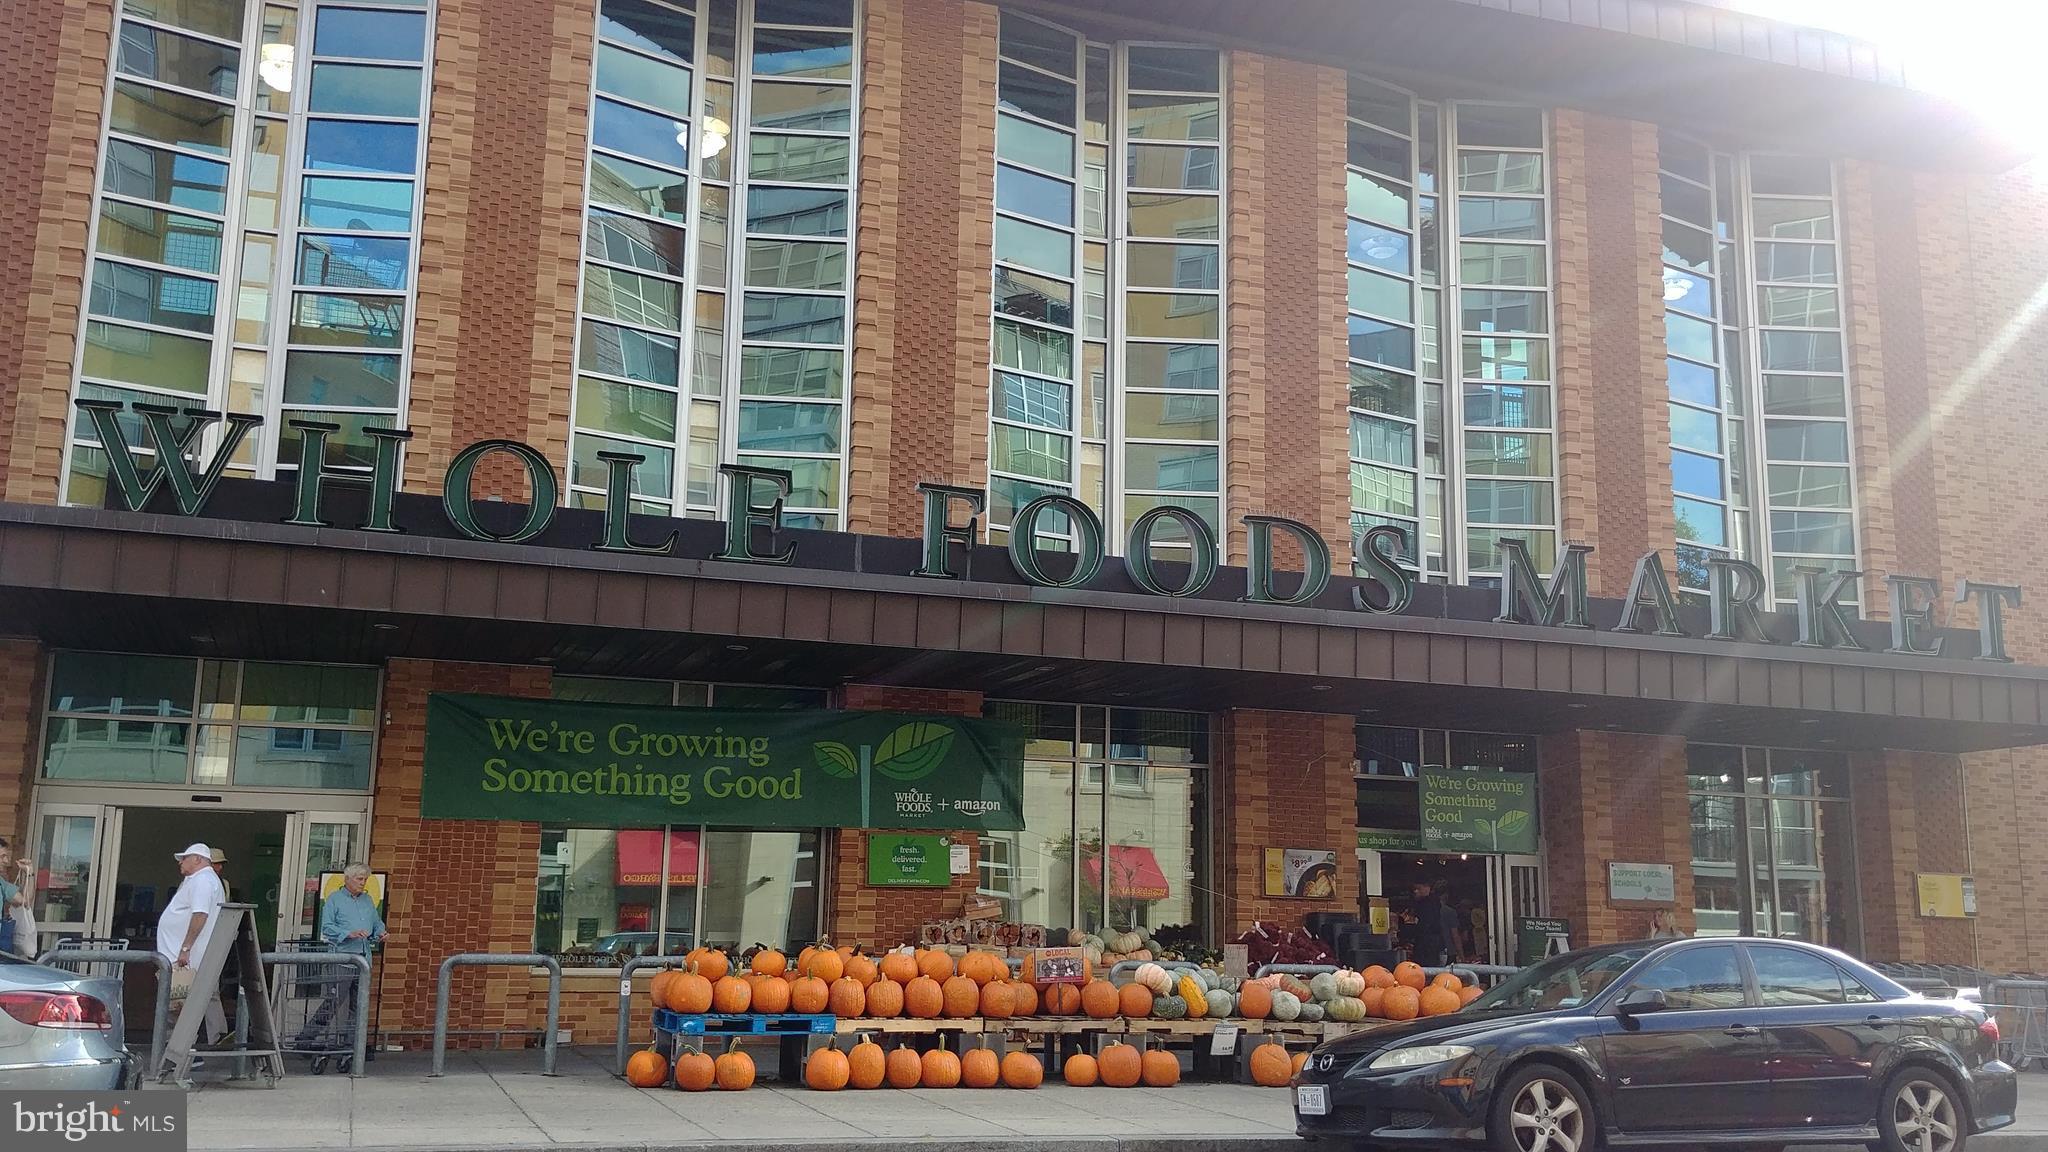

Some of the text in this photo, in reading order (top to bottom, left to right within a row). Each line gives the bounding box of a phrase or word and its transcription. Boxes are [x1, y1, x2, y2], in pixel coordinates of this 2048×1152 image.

[75, 399, 2022, 662] WHOLE FOODS MARKET
[485, 717, 770, 768] We're Growing
[481, 757, 803, 805] Something Good
[1425, 774, 1524, 795] We're Growing
[894, 790, 933, 802] WHOLE
[1424, 791, 1497, 811] Something
[954, 799, 1001, 813] amazon
[1424, 808, 1463, 824] Good
[1369, 836, 1388, 846] shop
[1389, 836, 1400, 845] for
[899, 846, 920, 854] fresh.
[891, 855, 928, 863] delivered.
[901, 864, 917, 872] fast.
